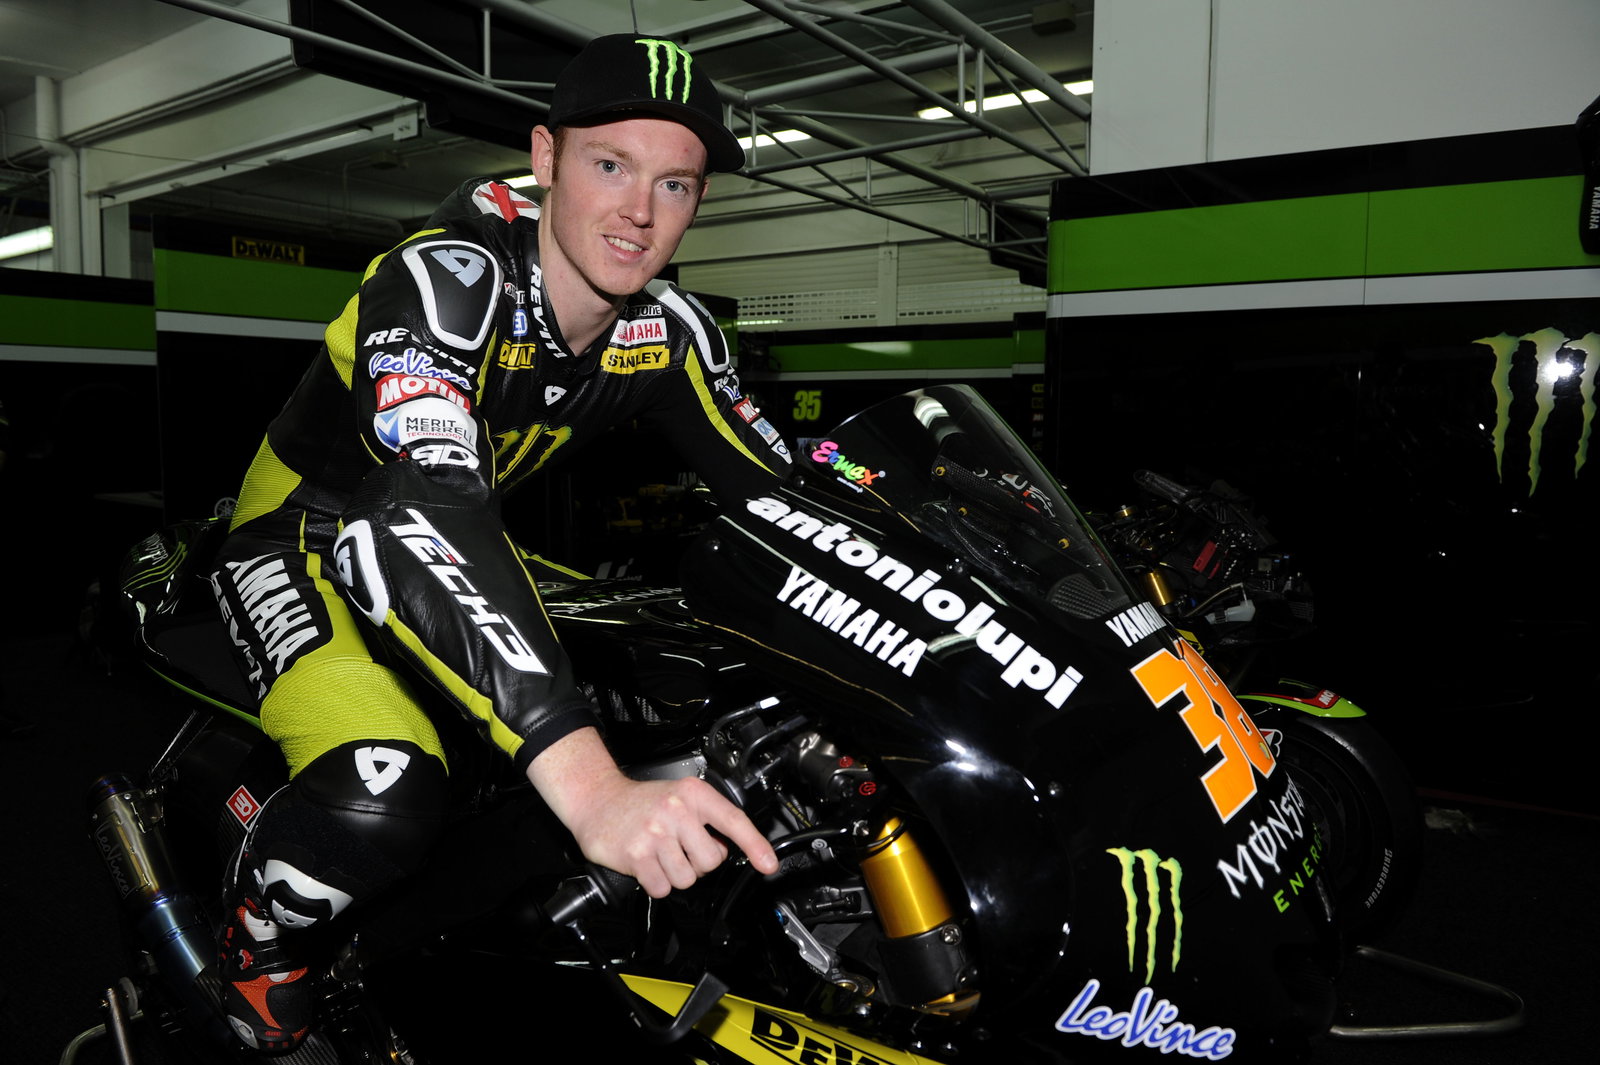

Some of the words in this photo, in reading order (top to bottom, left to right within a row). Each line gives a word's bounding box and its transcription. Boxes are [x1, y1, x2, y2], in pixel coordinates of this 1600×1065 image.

[608, 351, 663, 369] STANLEY
[379, 376, 471, 415] MOTUL
[793, 390, 821, 420] 35
[406, 416, 456, 428] MERIT
[406, 424, 475, 448] MERRELL
[407, 432, 462, 440] TECHNOLOGY
[225, 552, 319, 676] YAMAHA
[746, 497, 1084, 710] antoniolupi
[776, 565, 928, 678] YAMAHA
[1055, 978, 1236, 1060] LeoVince
